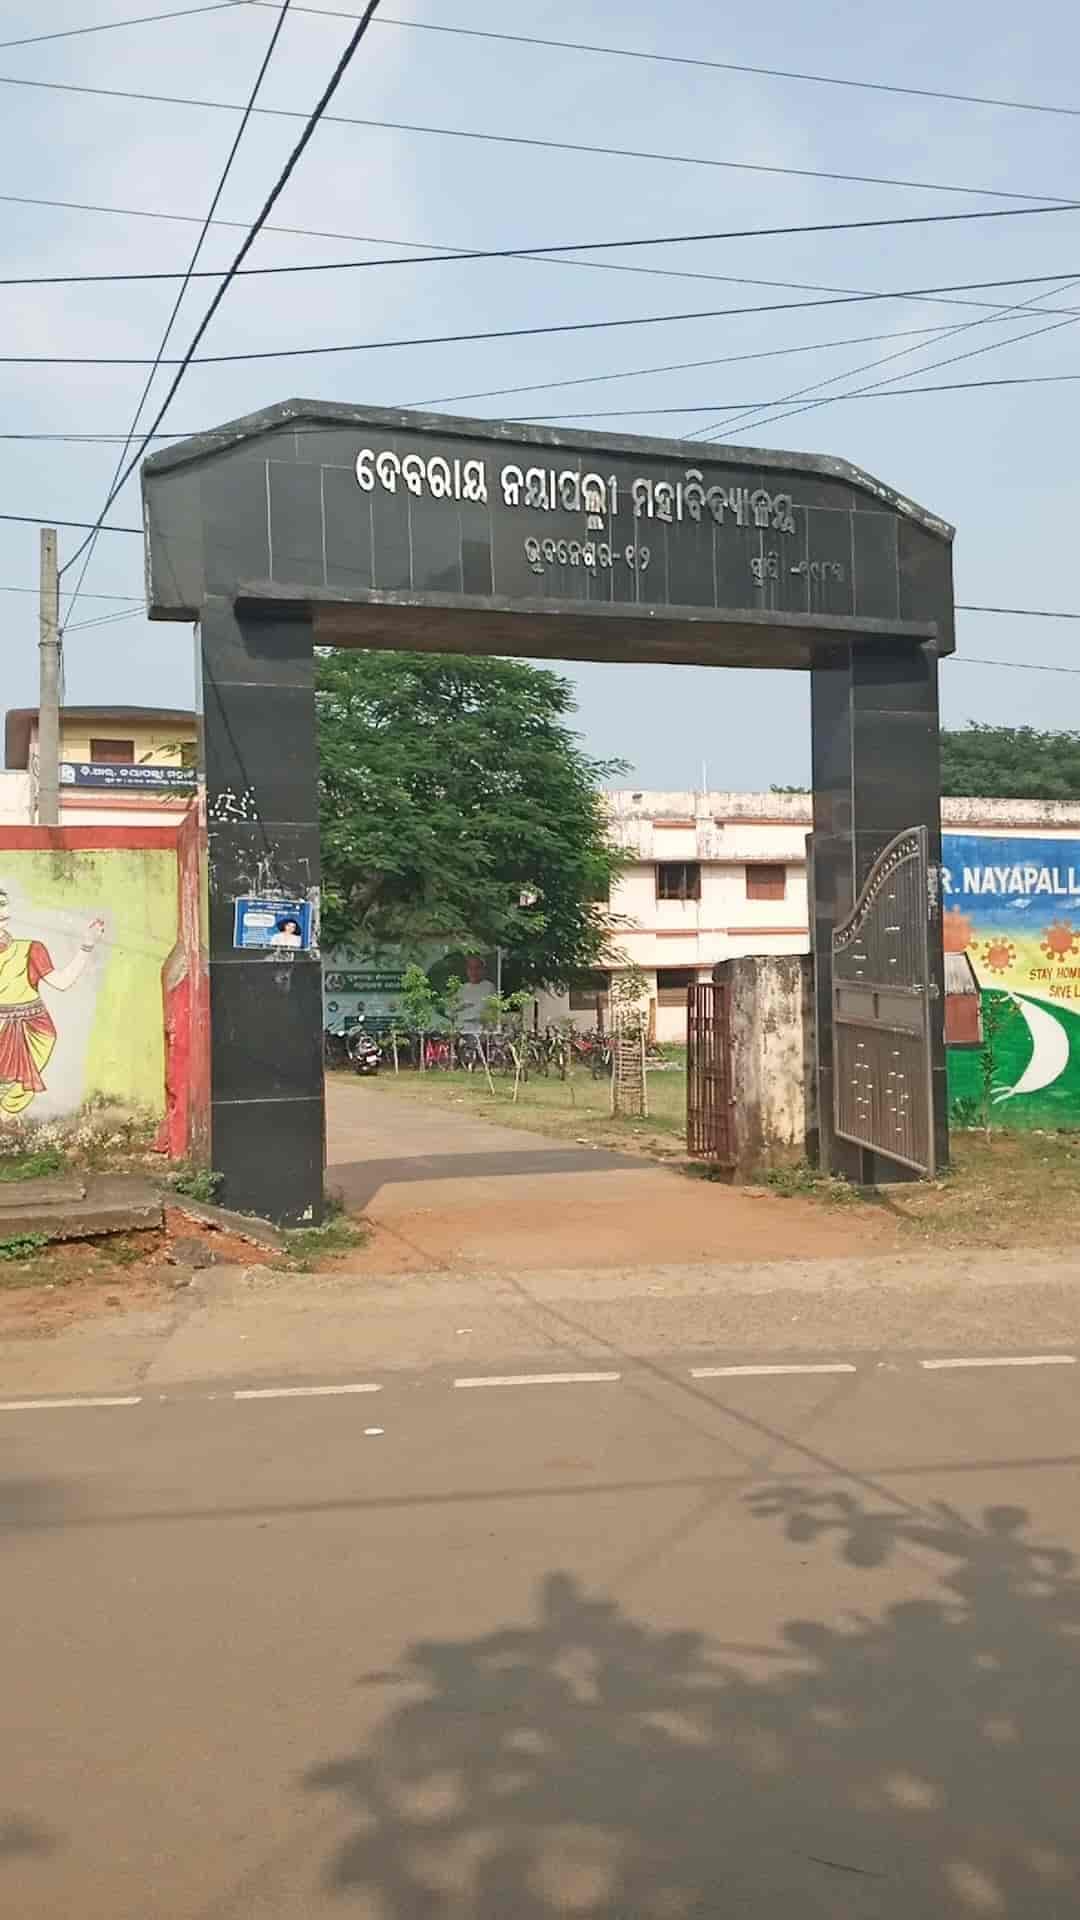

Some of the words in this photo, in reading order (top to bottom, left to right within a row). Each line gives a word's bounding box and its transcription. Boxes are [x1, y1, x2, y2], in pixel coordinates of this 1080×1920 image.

[355, 448, 487, 502] ଦେବରାୟ
[1029, 968, 1053, 981] STAY
[1049, 984, 1072, 998] SAVE
